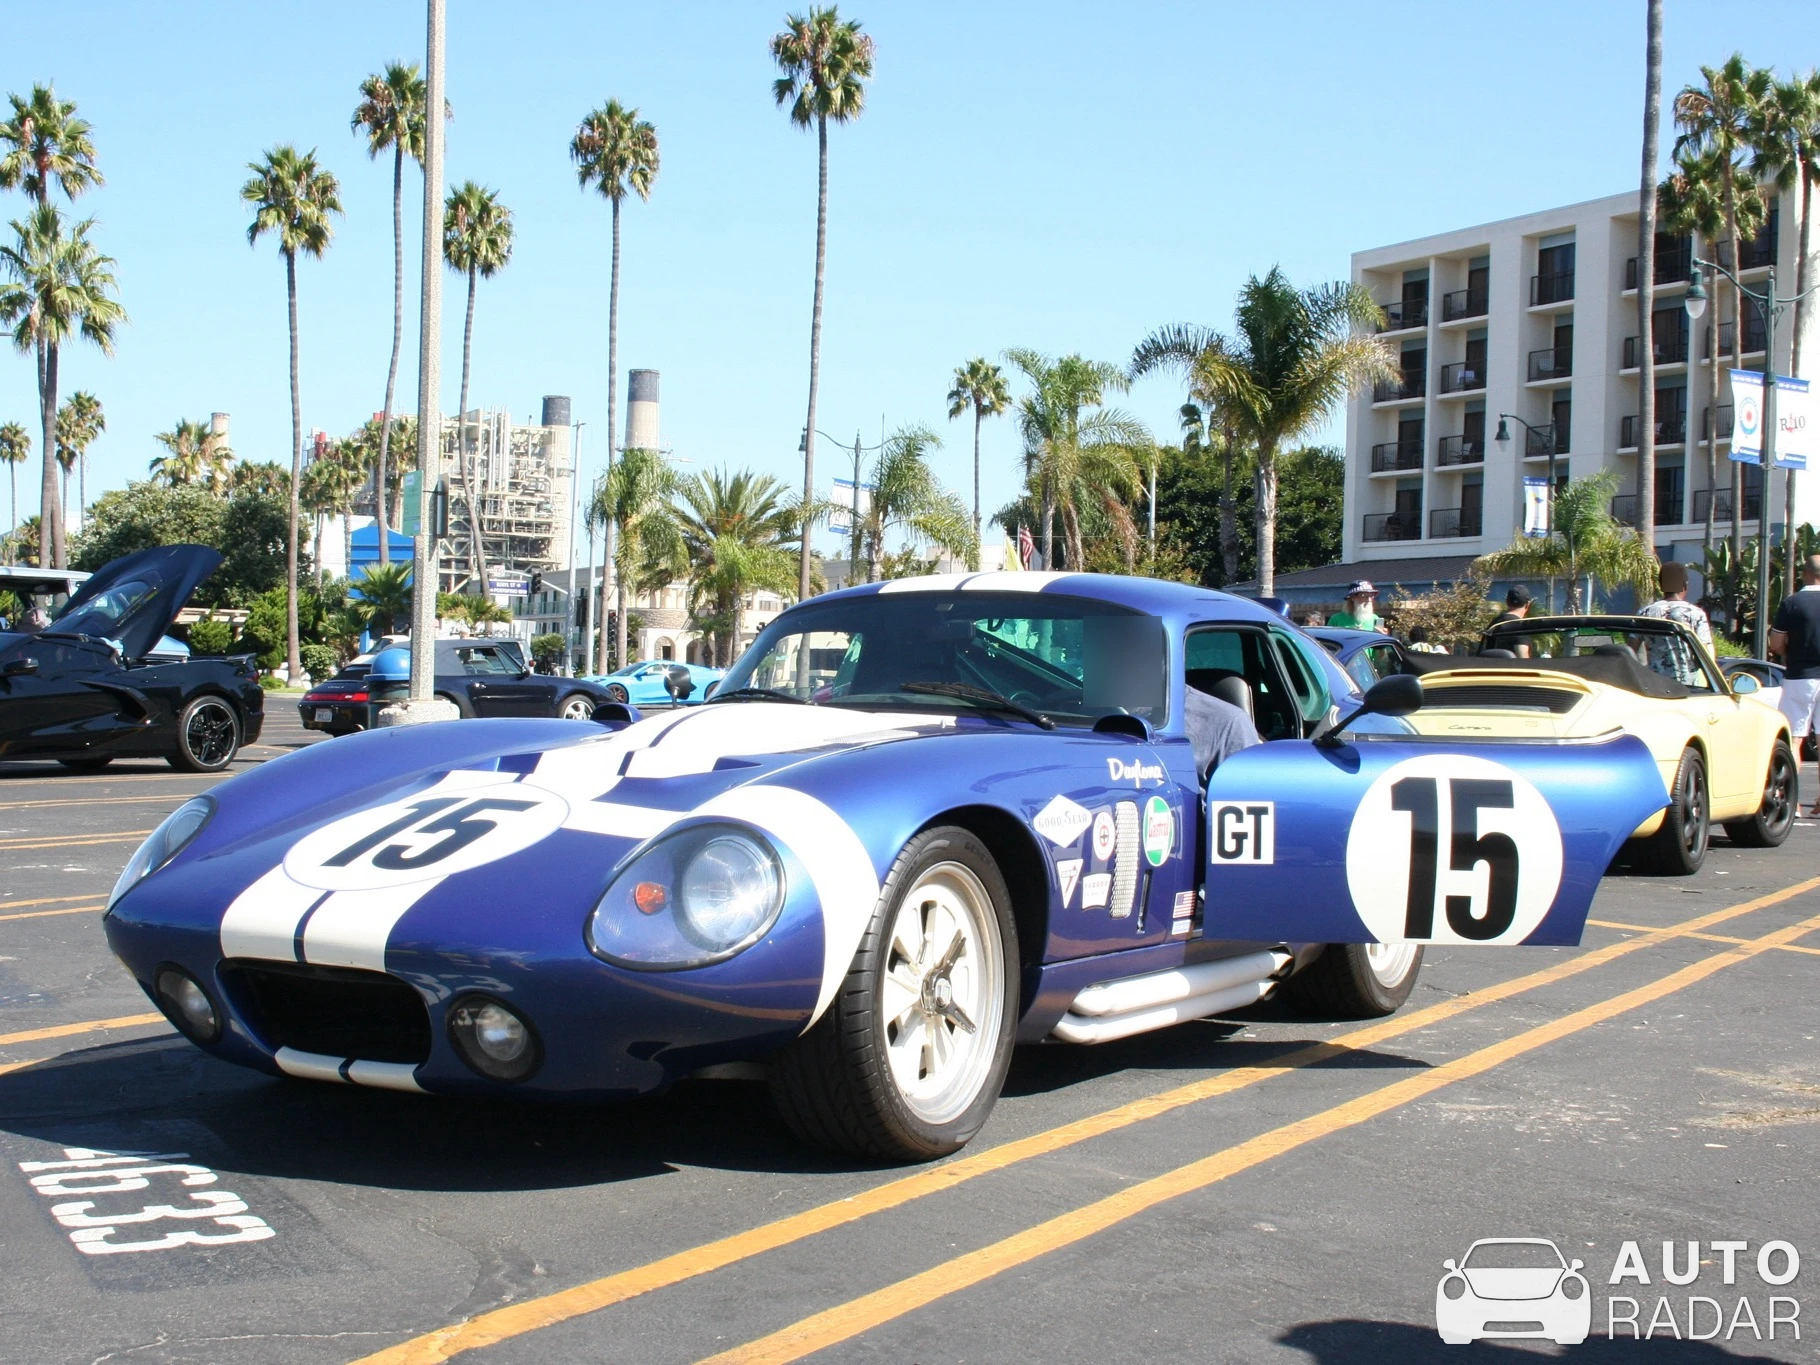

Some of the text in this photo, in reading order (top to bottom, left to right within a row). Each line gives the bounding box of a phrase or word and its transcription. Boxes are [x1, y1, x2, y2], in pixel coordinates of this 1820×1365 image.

[1106, 757, 1164, 788] Daytona
[320, 796, 542, 870] 15
[1216, 805, 1269, 860] GT
[1390, 776, 1520, 941] 15
